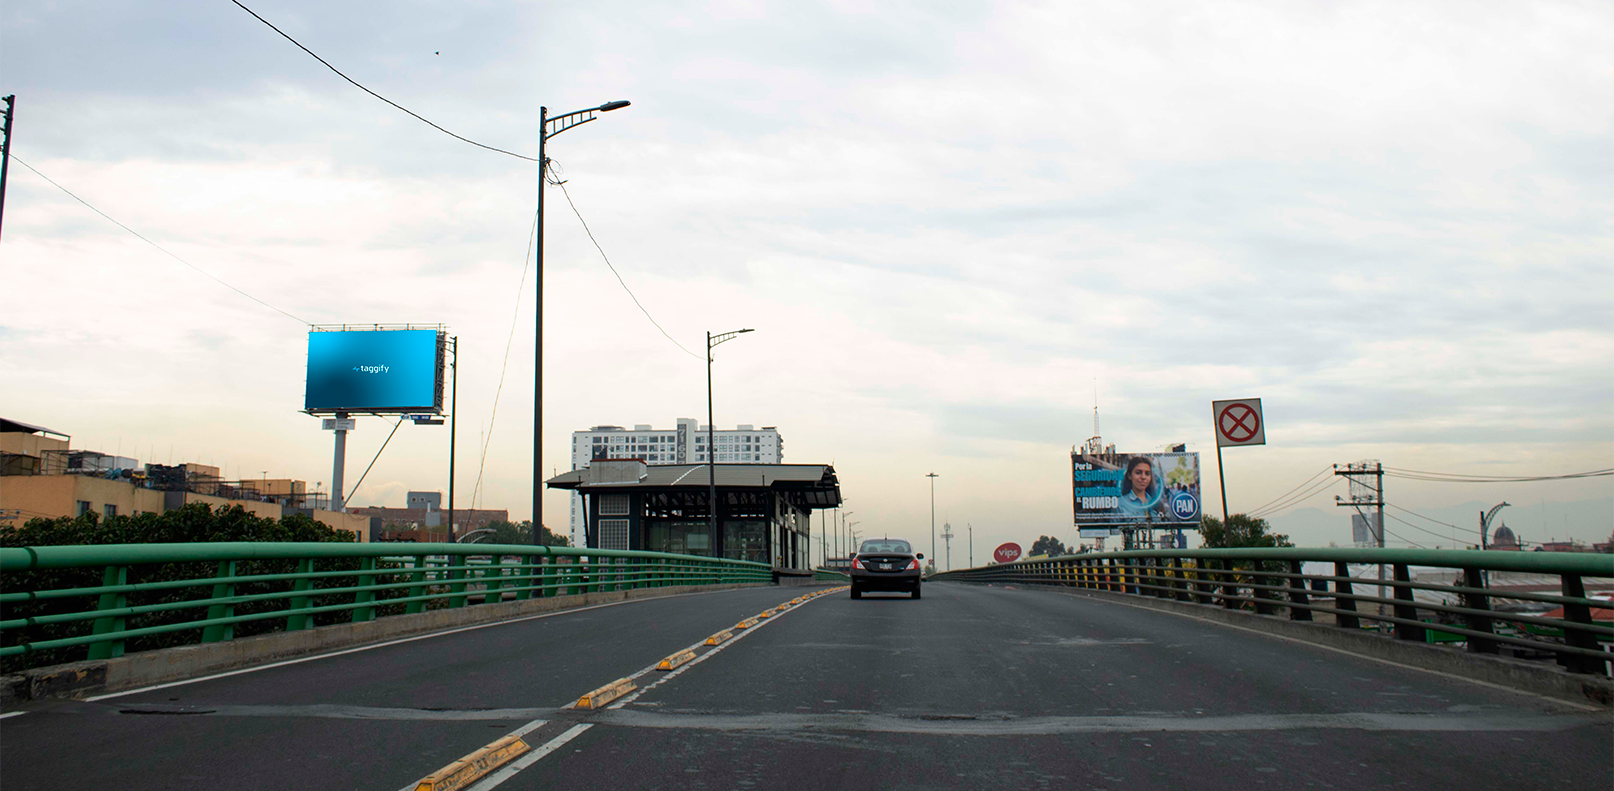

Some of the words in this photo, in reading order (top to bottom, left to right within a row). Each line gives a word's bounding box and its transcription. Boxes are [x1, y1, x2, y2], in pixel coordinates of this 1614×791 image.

[360, 364, 390, 374] taggify
[1075, 462, 1085, 470] Por
[1085, 462, 1092, 470] la
[1082, 496, 1119, 509] RUMBO
[1176, 499, 1194, 513] PAN
[998, 548, 1018, 559] vips
